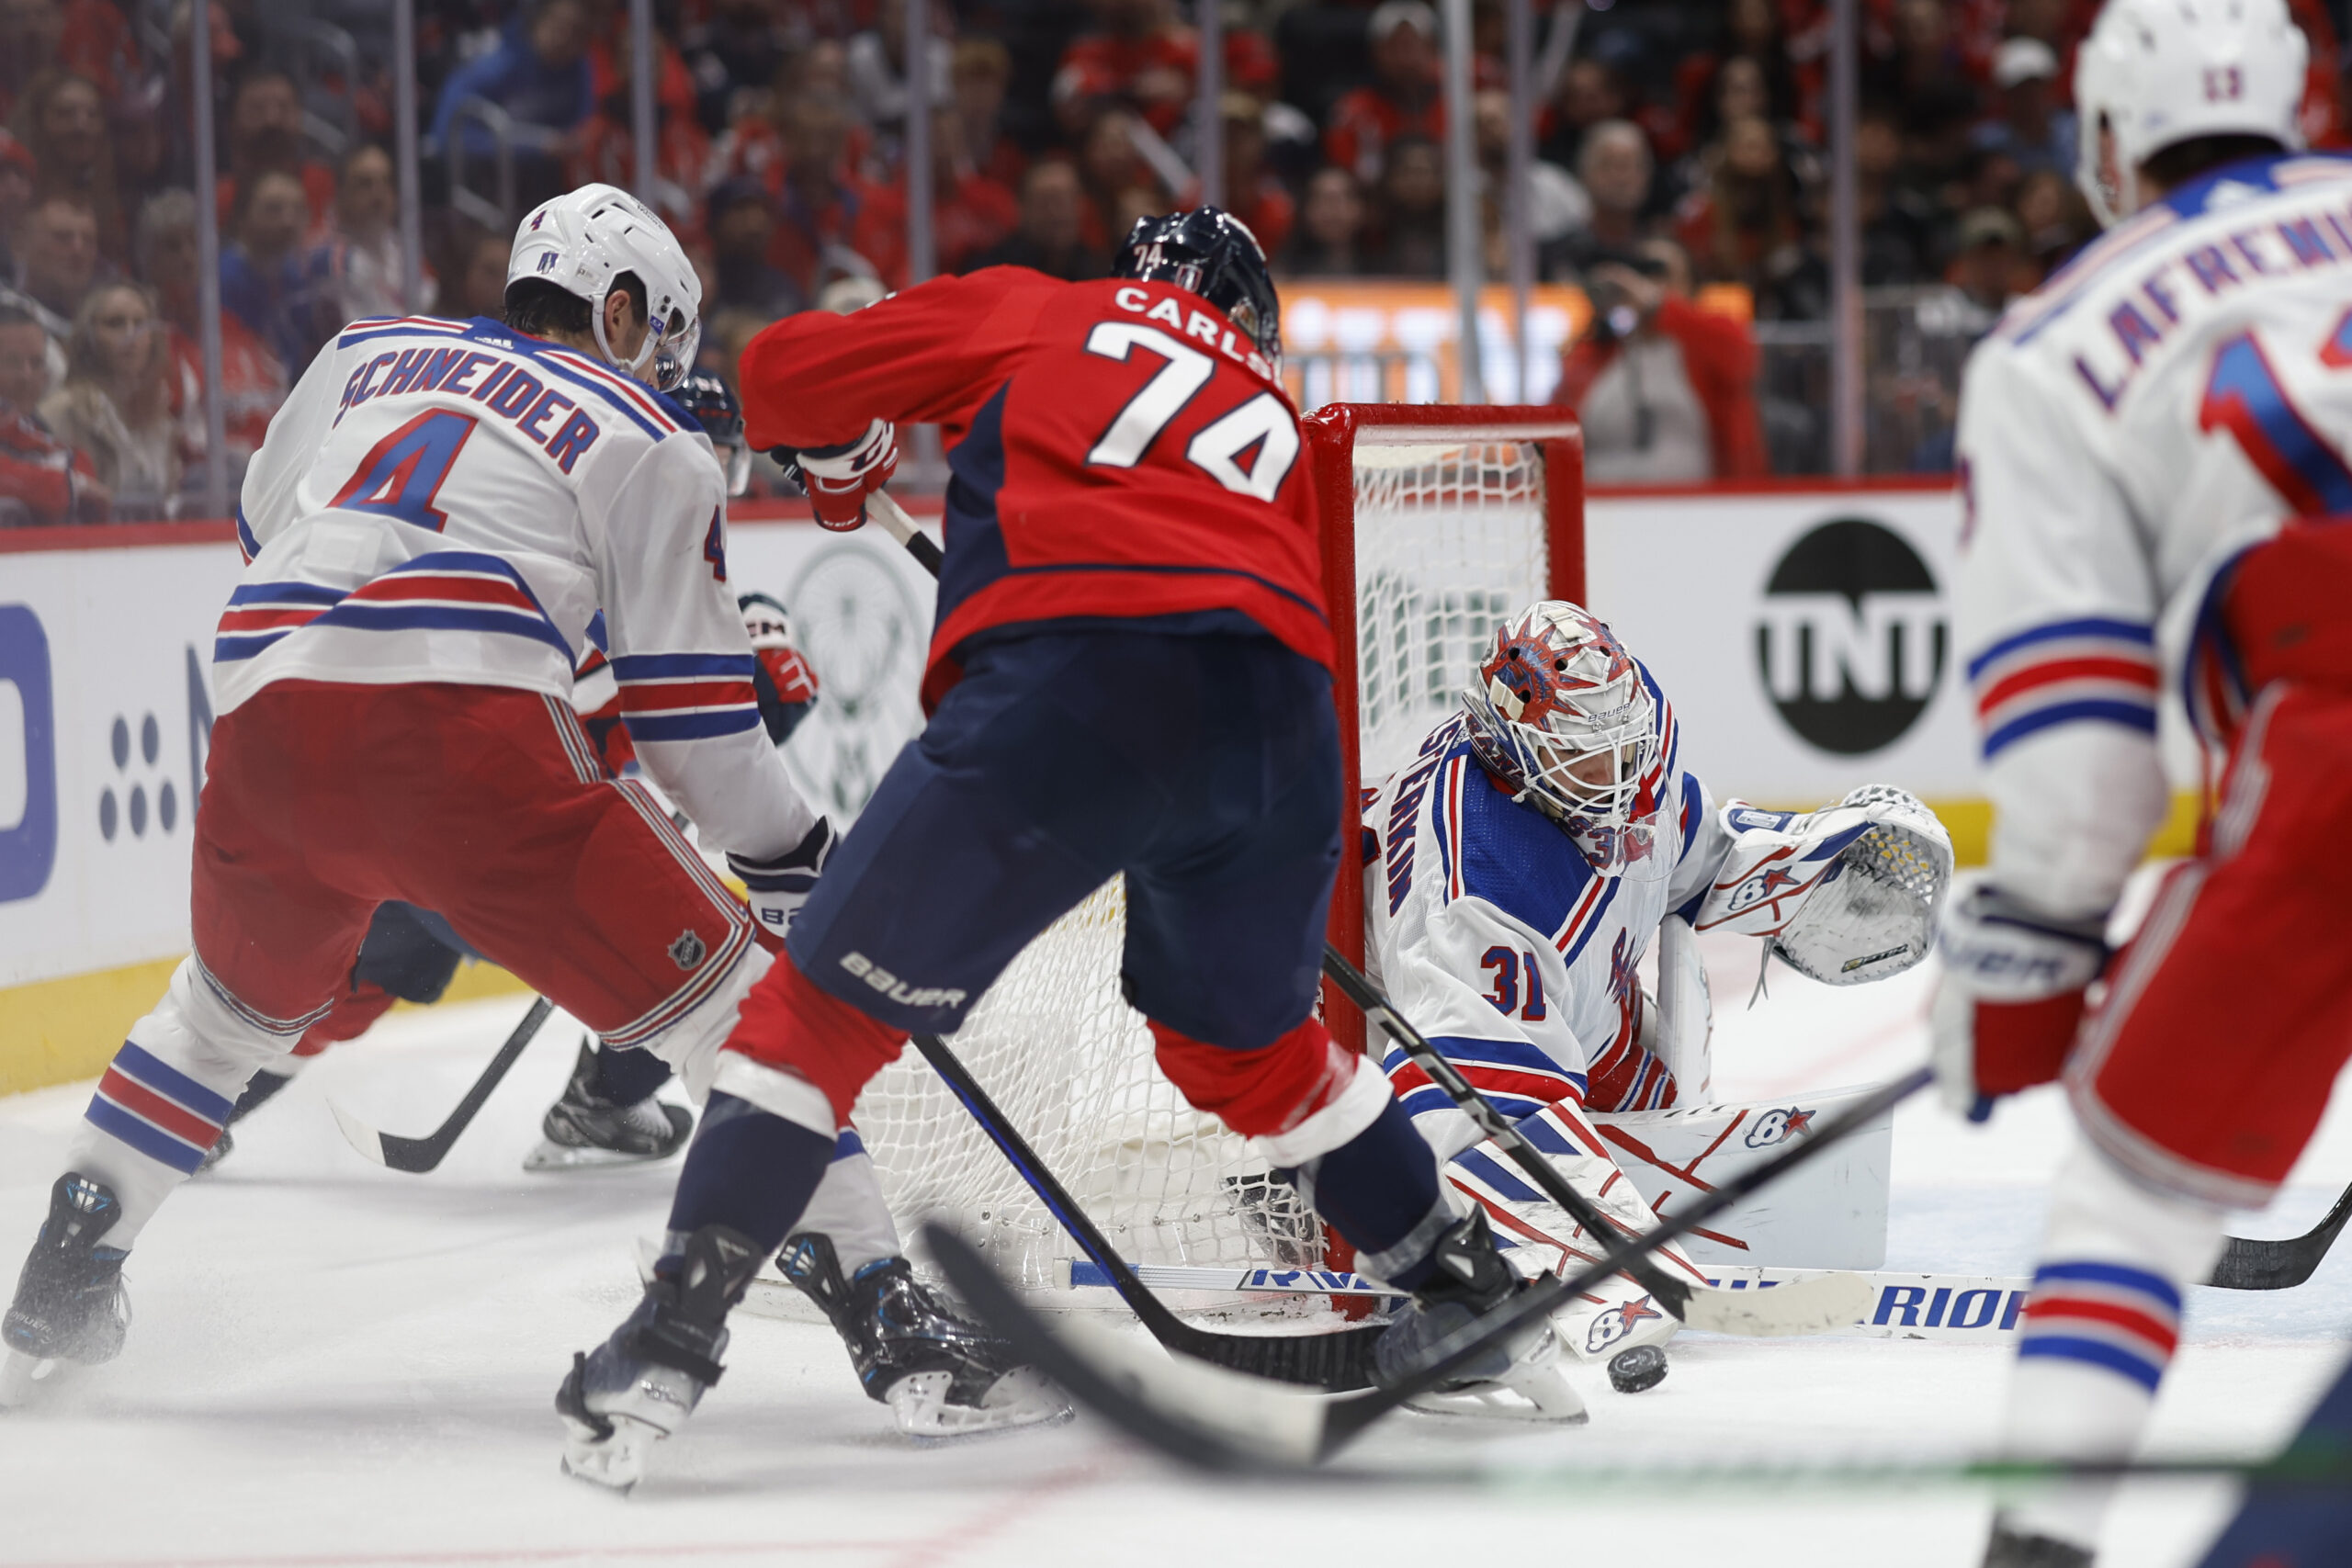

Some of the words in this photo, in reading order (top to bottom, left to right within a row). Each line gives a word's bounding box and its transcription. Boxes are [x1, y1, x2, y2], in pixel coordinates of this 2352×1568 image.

[529, 209, 548, 231] 4
[1133, 242, 1163, 273] 74
[1114, 286, 1284, 390] CARLS
[332, 347, 601, 476] SCHNEIDER
[1083, 321, 1301, 504] 74
[324, 407, 481, 535] 4
[704, 503, 727, 584] 4
[1751, 593, 1951, 703] TNT
[1588, 702, 1631, 723] BAUER
[840, 951, 967, 1010] BAUER
[1479, 944, 1546, 1021] 31
